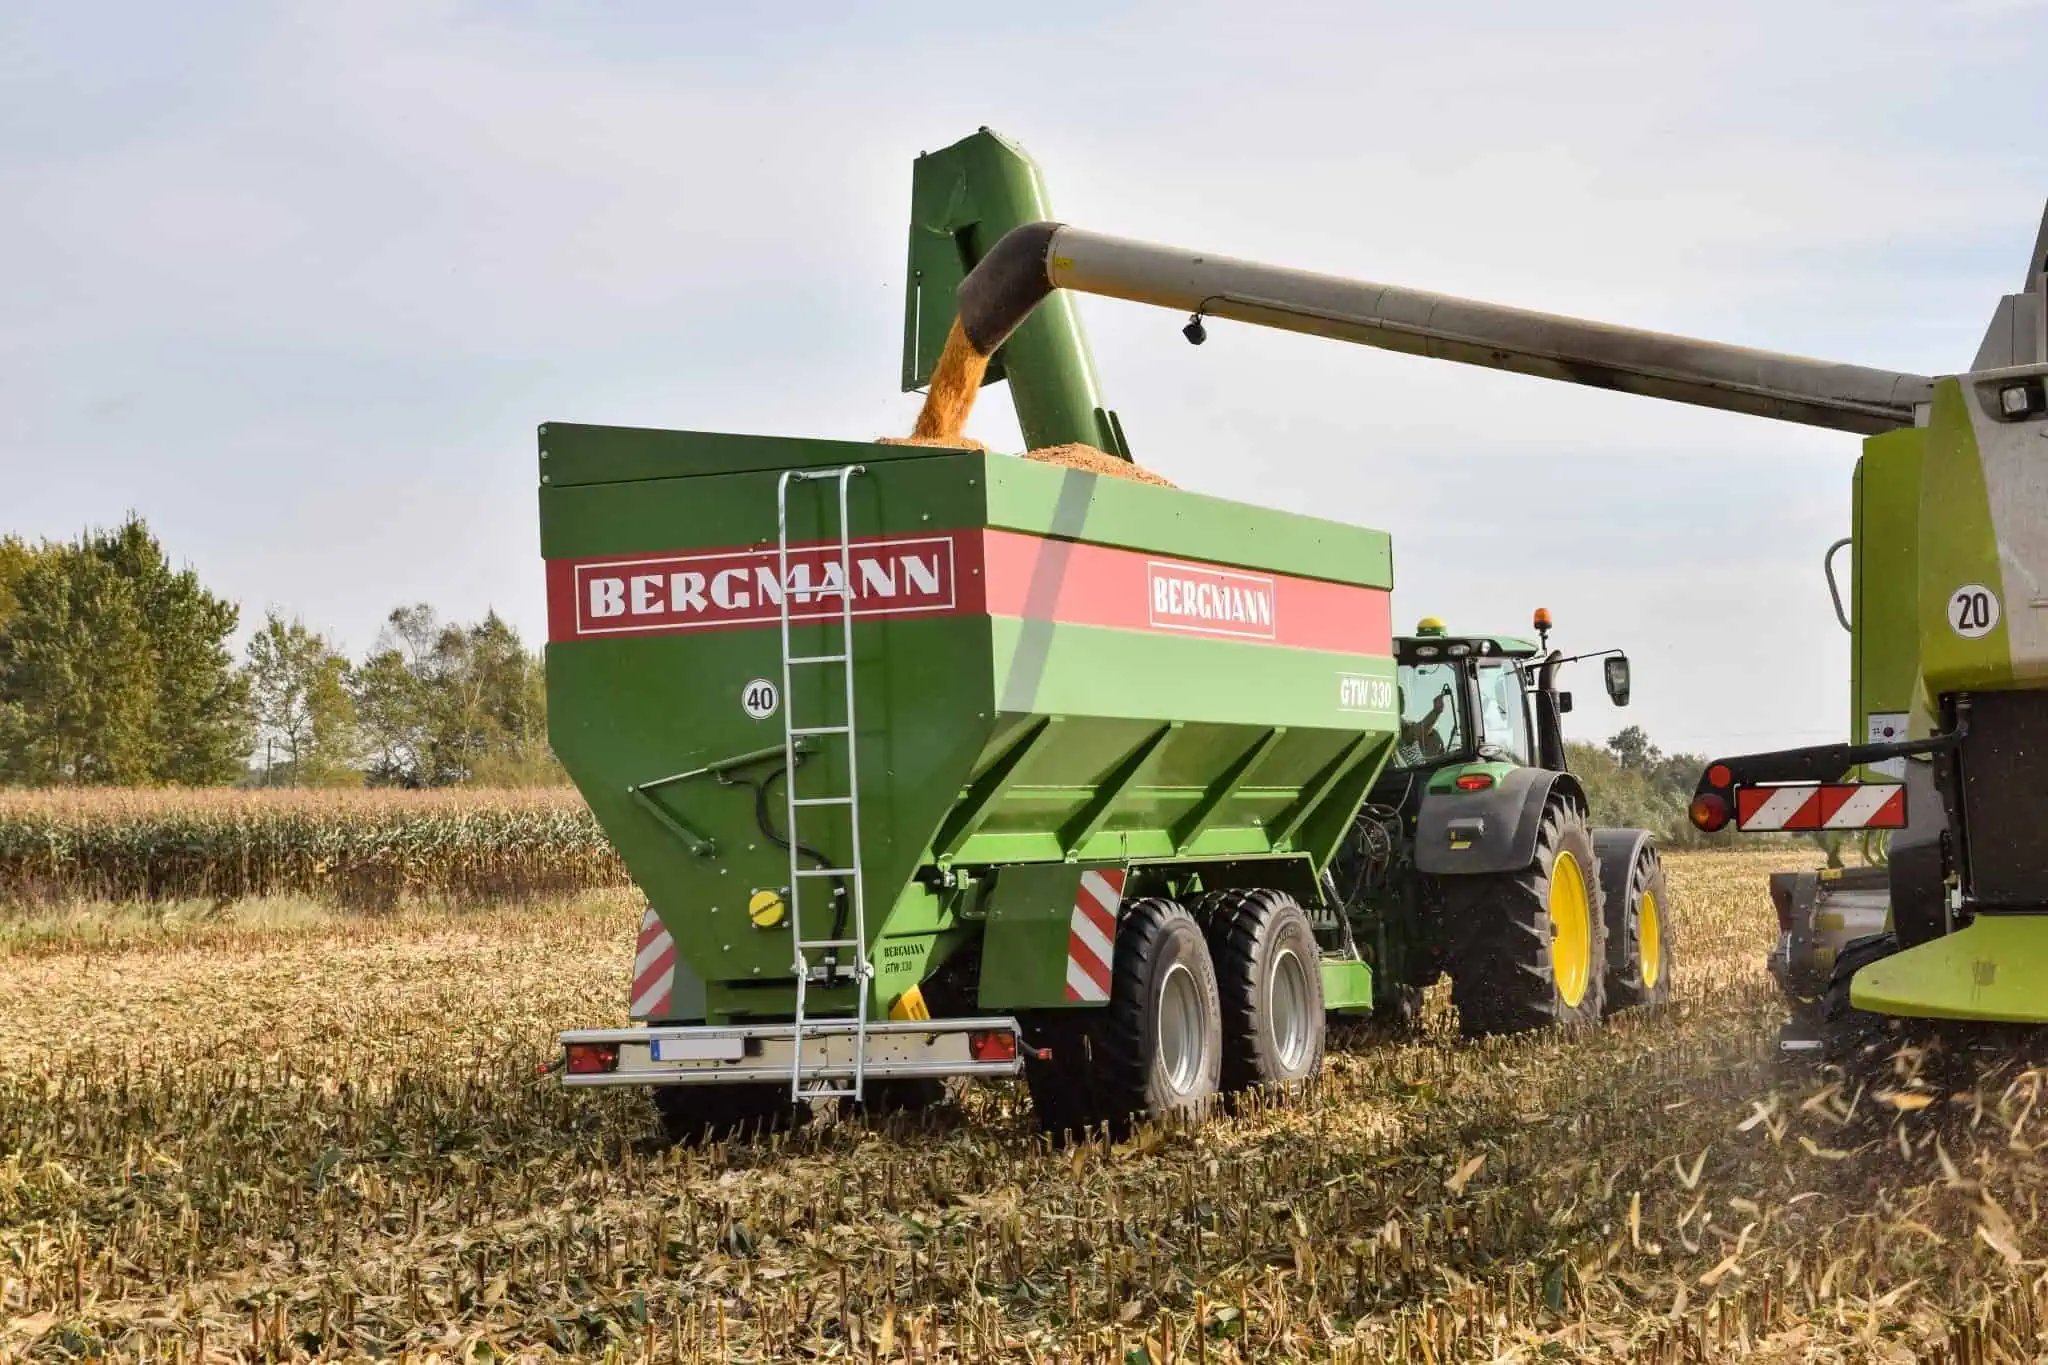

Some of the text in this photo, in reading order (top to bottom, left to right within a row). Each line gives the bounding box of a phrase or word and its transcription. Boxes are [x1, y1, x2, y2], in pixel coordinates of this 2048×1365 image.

[590, 554, 939, 617] BERGMANN
[1154, 576, 1270, 625] BERGMANN
[1957, 593, 1989, 628] 20
[748, 688, 773, 710] 40
[1341, 679, 1392, 708] GTW 330
